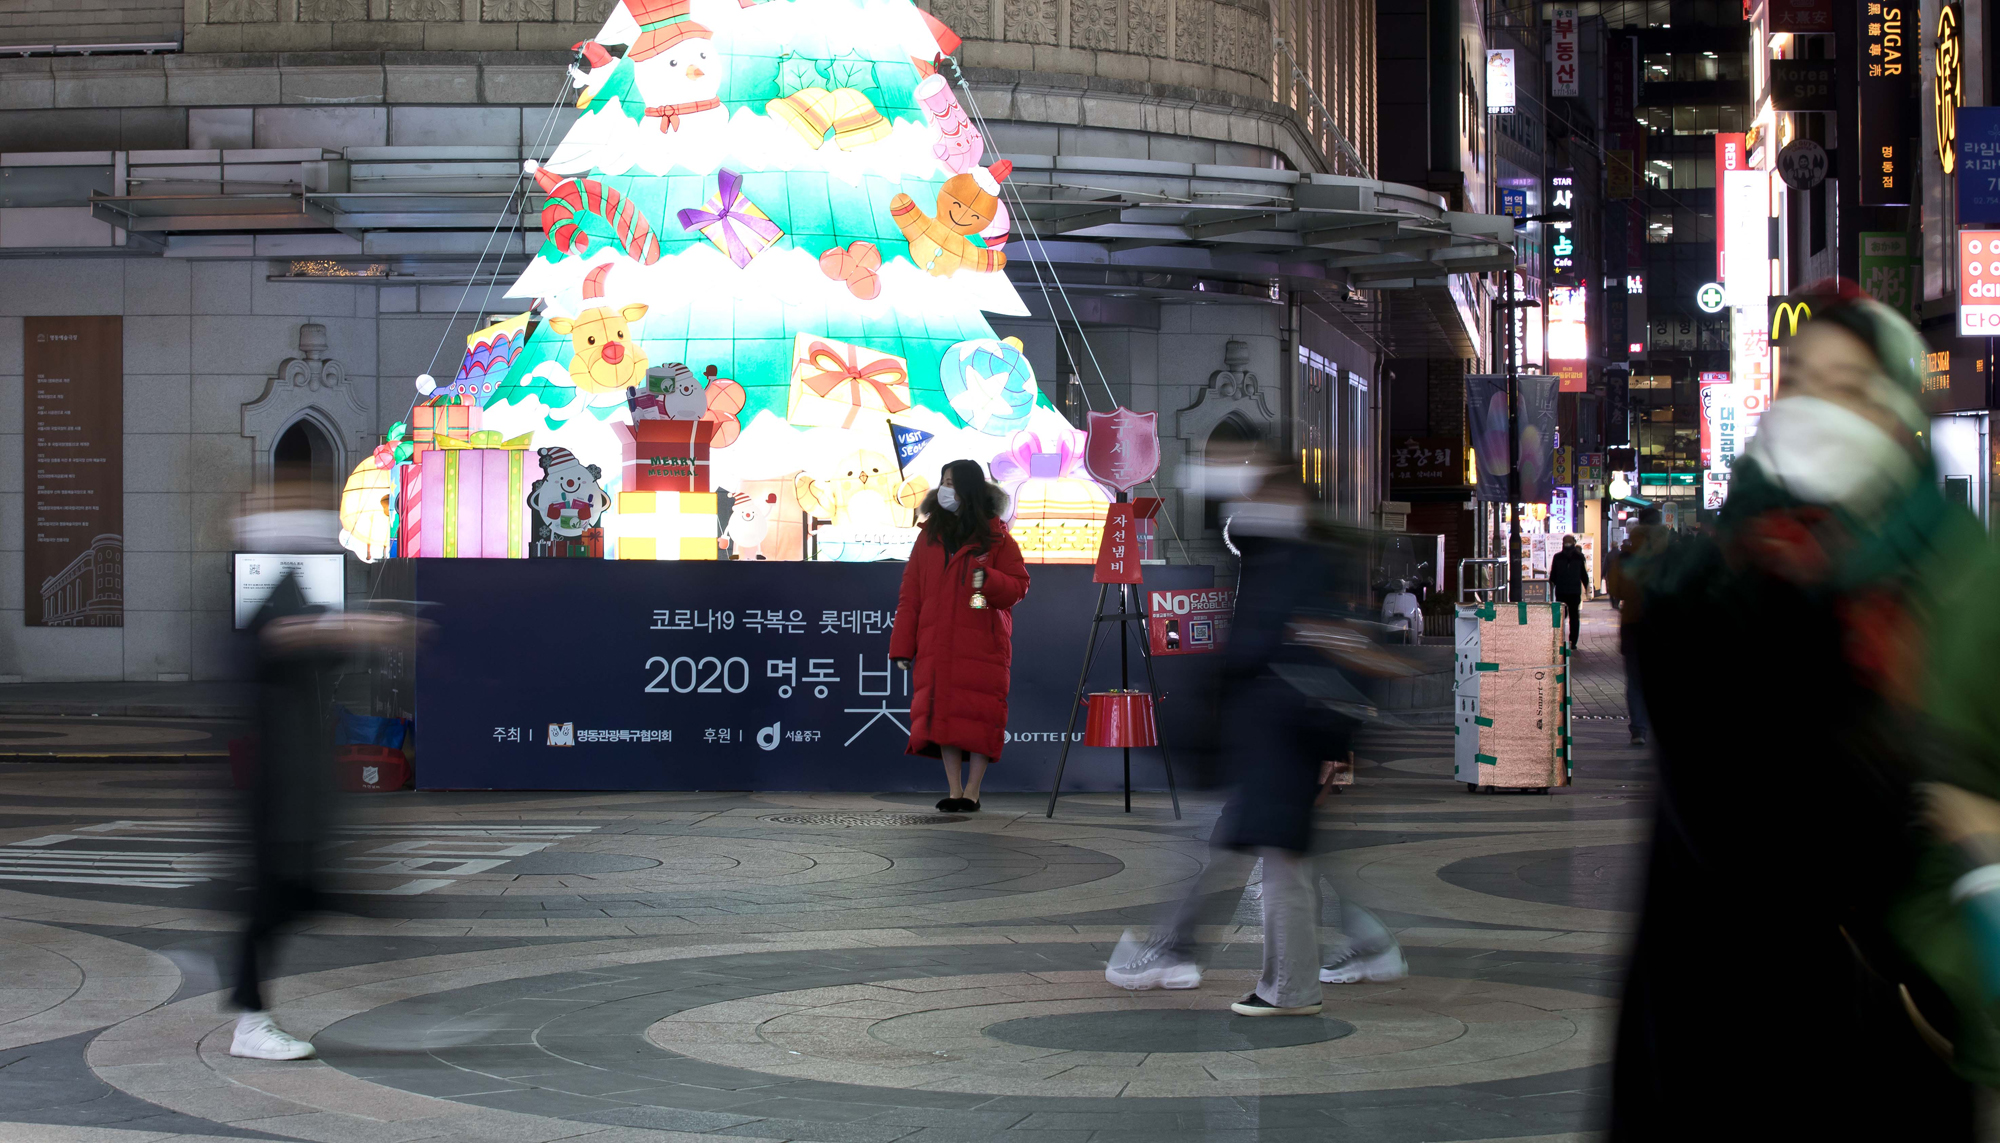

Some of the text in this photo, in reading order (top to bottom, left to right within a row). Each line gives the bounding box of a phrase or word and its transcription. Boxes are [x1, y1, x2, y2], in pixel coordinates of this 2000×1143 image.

[1883, 7, 1902, 77] SUGAR
[1555, 19, 1575, 84] 부동산
[1777, 67, 1829, 82] Korea
[1725, 142, 1736, 170] RED
[1882, 146, 1895, 188] 명동점
[1965, 159, 2000, 170] 치과
[1553, 177, 1573, 186] STAR
[1988, 178, 2000, 191] 7
[1504, 195, 1523, 206] 번역
[1554, 258, 1573, 268] Cafe
[1743, 329, 1770, 359] 药
[898, 431, 922, 444] VISIT
[1110, 417, 1133, 481] 구세군
[650, 456, 697, 467] MERRY
[1592, 456, 1602, 465] 元
[648, 468, 700, 477] MEDIHEAL
[1110, 513, 1128, 574] 자선냄비
[1152, 591, 1235, 615] NO CASH?
[649, 608, 735, 635] 코로나19
[742, 608, 807, 635] 극복은
[644, 656, 749, 694] 2020
[766, 656, 841, 700] 명동
[1533, 671, 1546, 716] Smart-Q
[492, 727, 521, 743] 주최
[577, 729, 672, 743] 명동관광특구협의회
[703, 727, 732, 744] 후원
[785, 730, 821, 742] 서울중구
[1014, 732, 1058, 742] LOTTE
